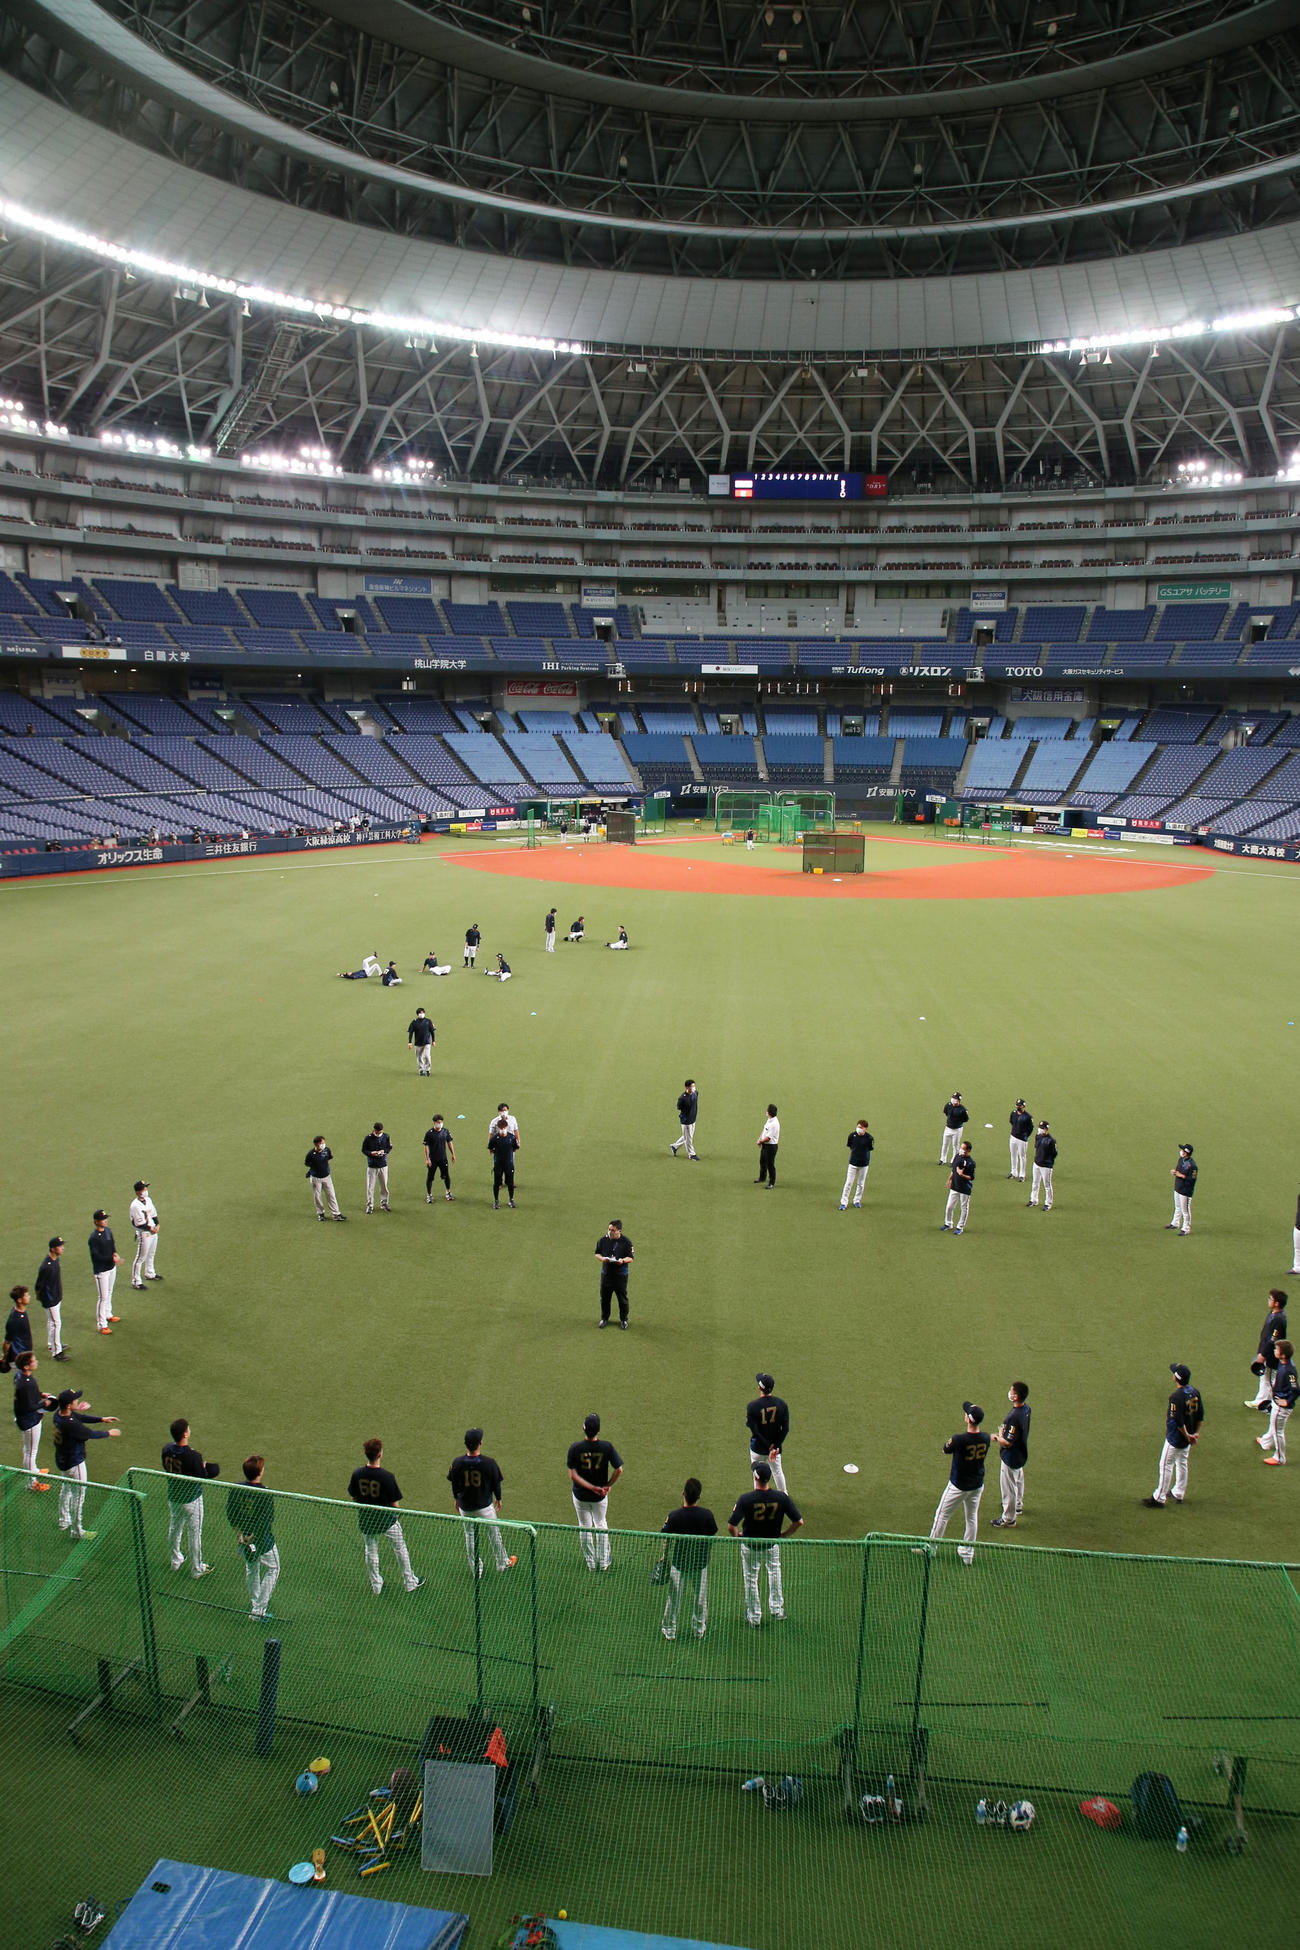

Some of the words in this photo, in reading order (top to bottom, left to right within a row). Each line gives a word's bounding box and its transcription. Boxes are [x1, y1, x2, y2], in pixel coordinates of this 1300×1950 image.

[1160, 588, 1193, 597] GSユアサ
[1195, 587, 1228, 596] バッテリー
[414, 659, 467, 669] 桃山学院大学
[542, 661, 560, 670] IHI
[846, 666, 885, 675] Tuflong
[910, 666, 952, 676] リスロン
[1006, 666, 1043, 677] TOTO
[1023, 690, 1084, 702] 大阪信用金庫
[205, 842, 257, 856] 三井住友銀行
[1241, 844, 1286, 857] 大商大高校
[97, 847, 163, 865] オリックス生命
[760, 1406, 777, 1425] 17
[965, 1443, 987, 1461] 32
[580, 1453, 604, 1470] 57
[464, 1470, 482, 1487] 18
[359, 1478, 381, 1497] 68
[753, 1503, 779, 1521] 27
